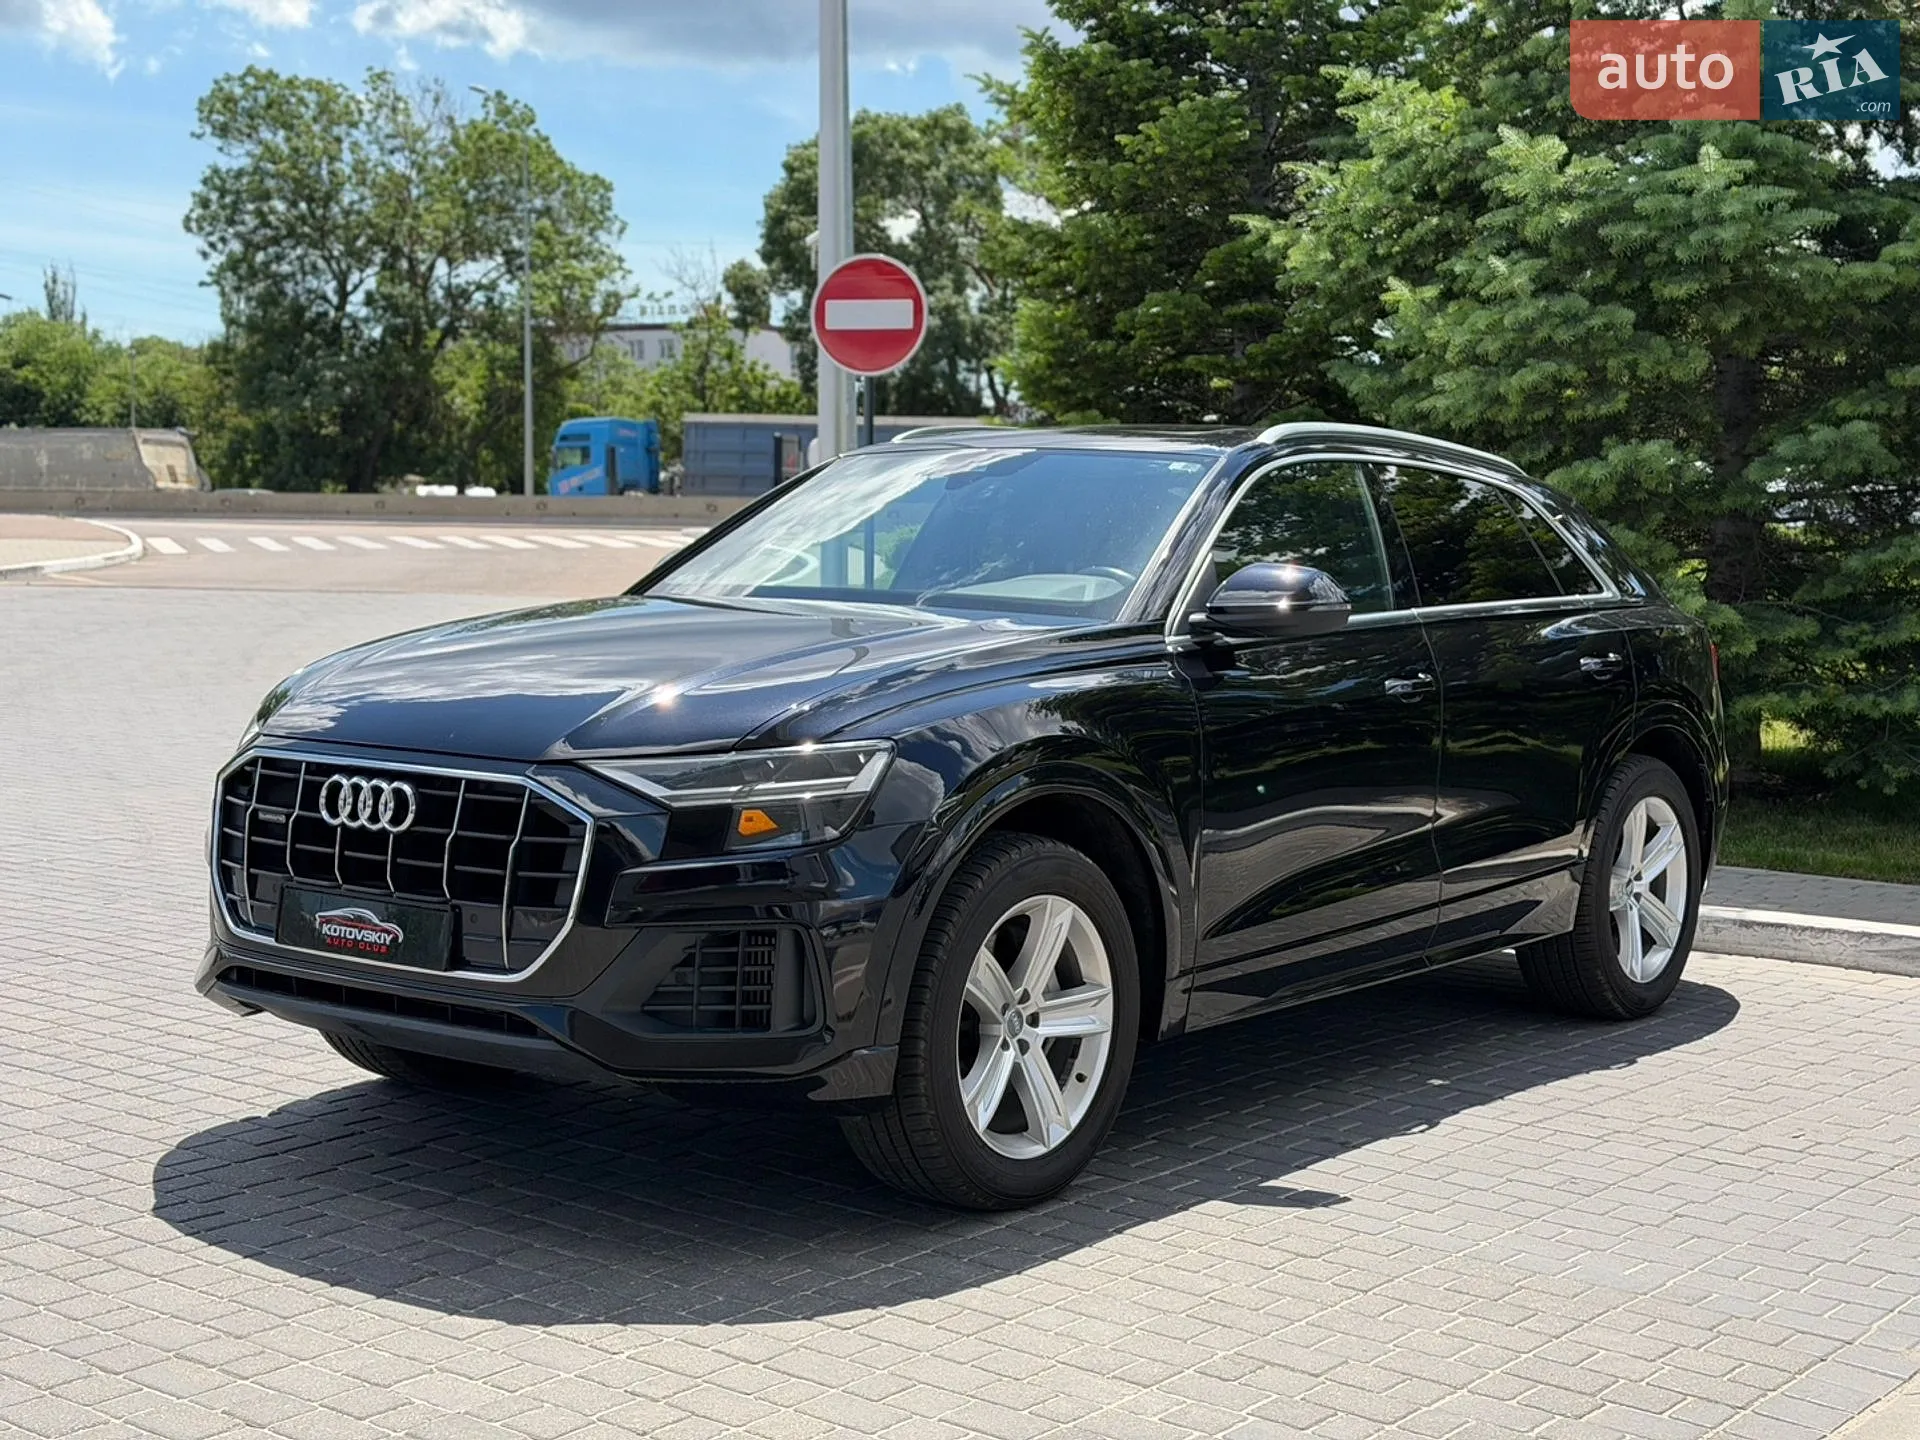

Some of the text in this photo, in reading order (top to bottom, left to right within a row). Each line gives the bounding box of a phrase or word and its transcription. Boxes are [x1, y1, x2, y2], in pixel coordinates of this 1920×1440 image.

[322, 923, 393, 945] KOTOVSKIY
[326, 938, 388, 954] AUTO CLUB
